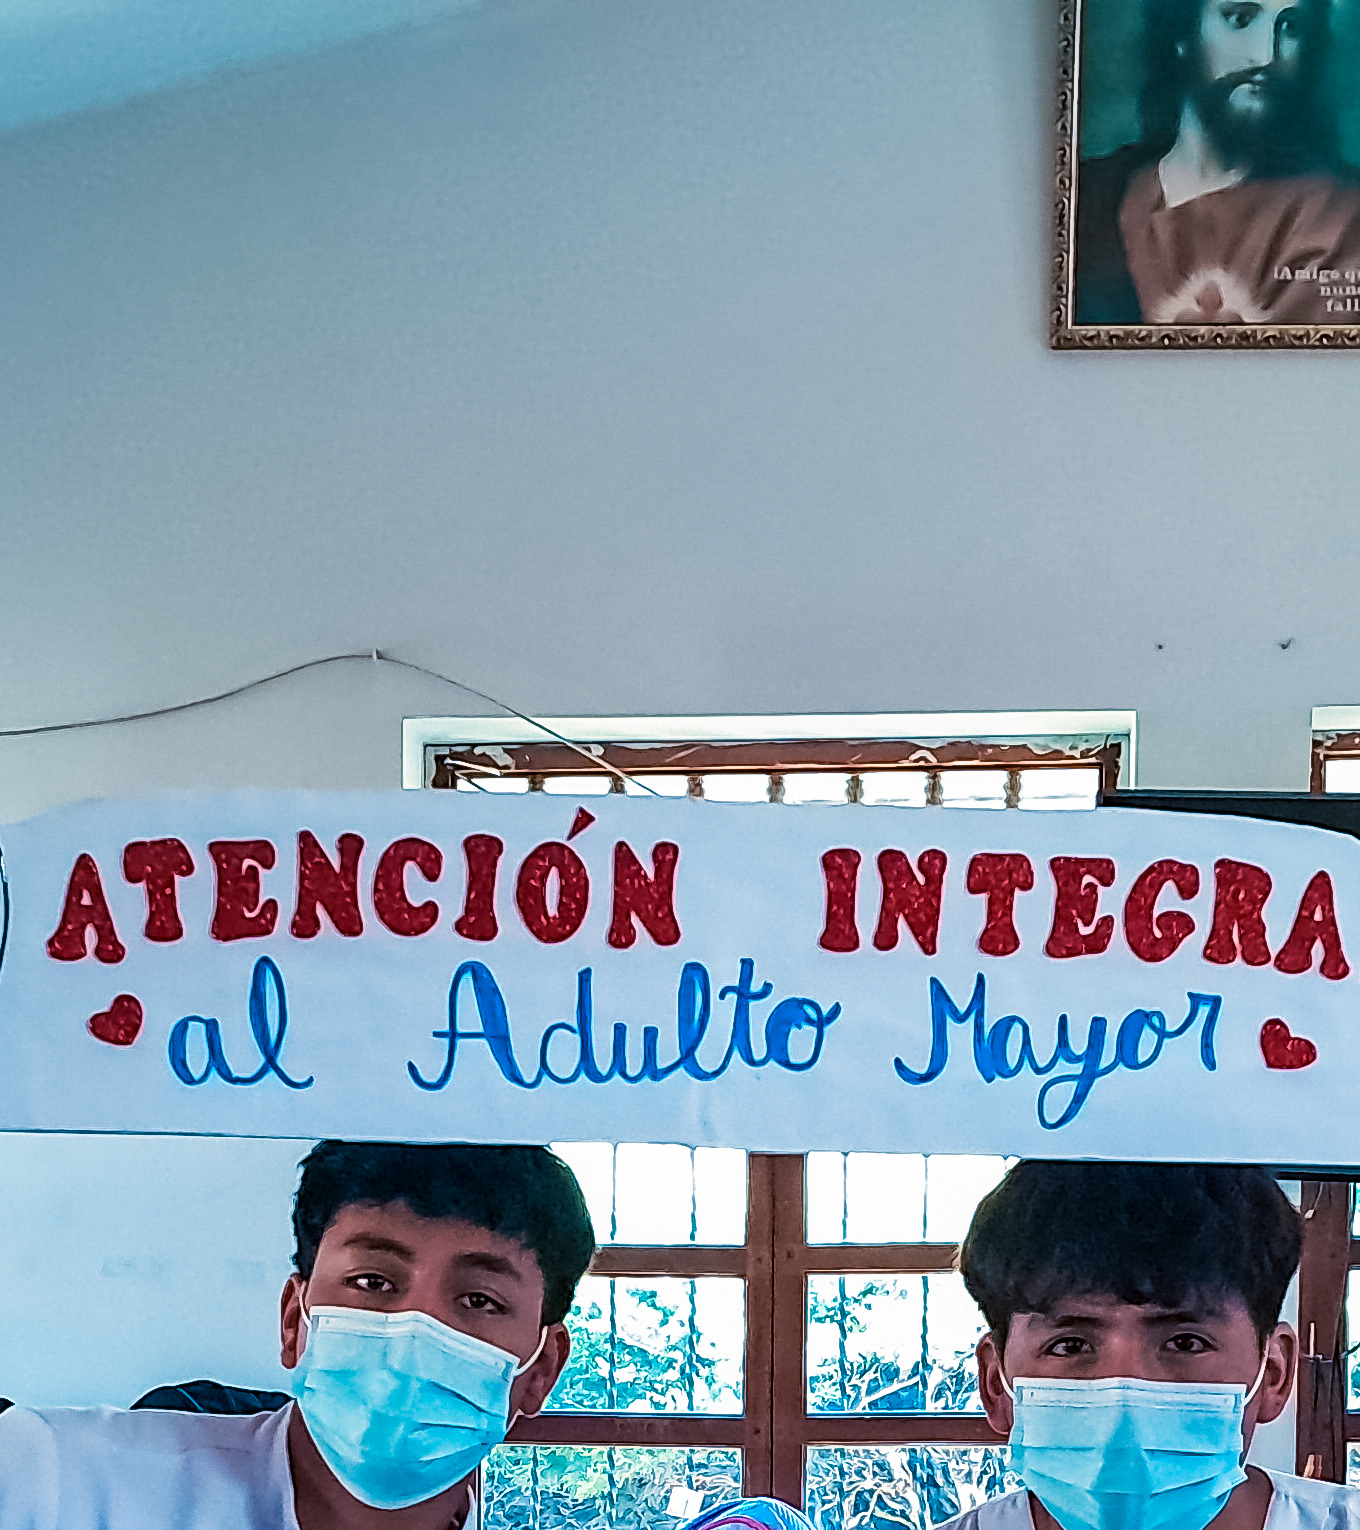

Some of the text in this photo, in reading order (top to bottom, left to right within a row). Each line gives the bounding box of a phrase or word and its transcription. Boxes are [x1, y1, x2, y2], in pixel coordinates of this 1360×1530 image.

[45, 805, 682, 964] ATENCIÓN
[167, 956, 1222, 1130] al Adulto Mayor
